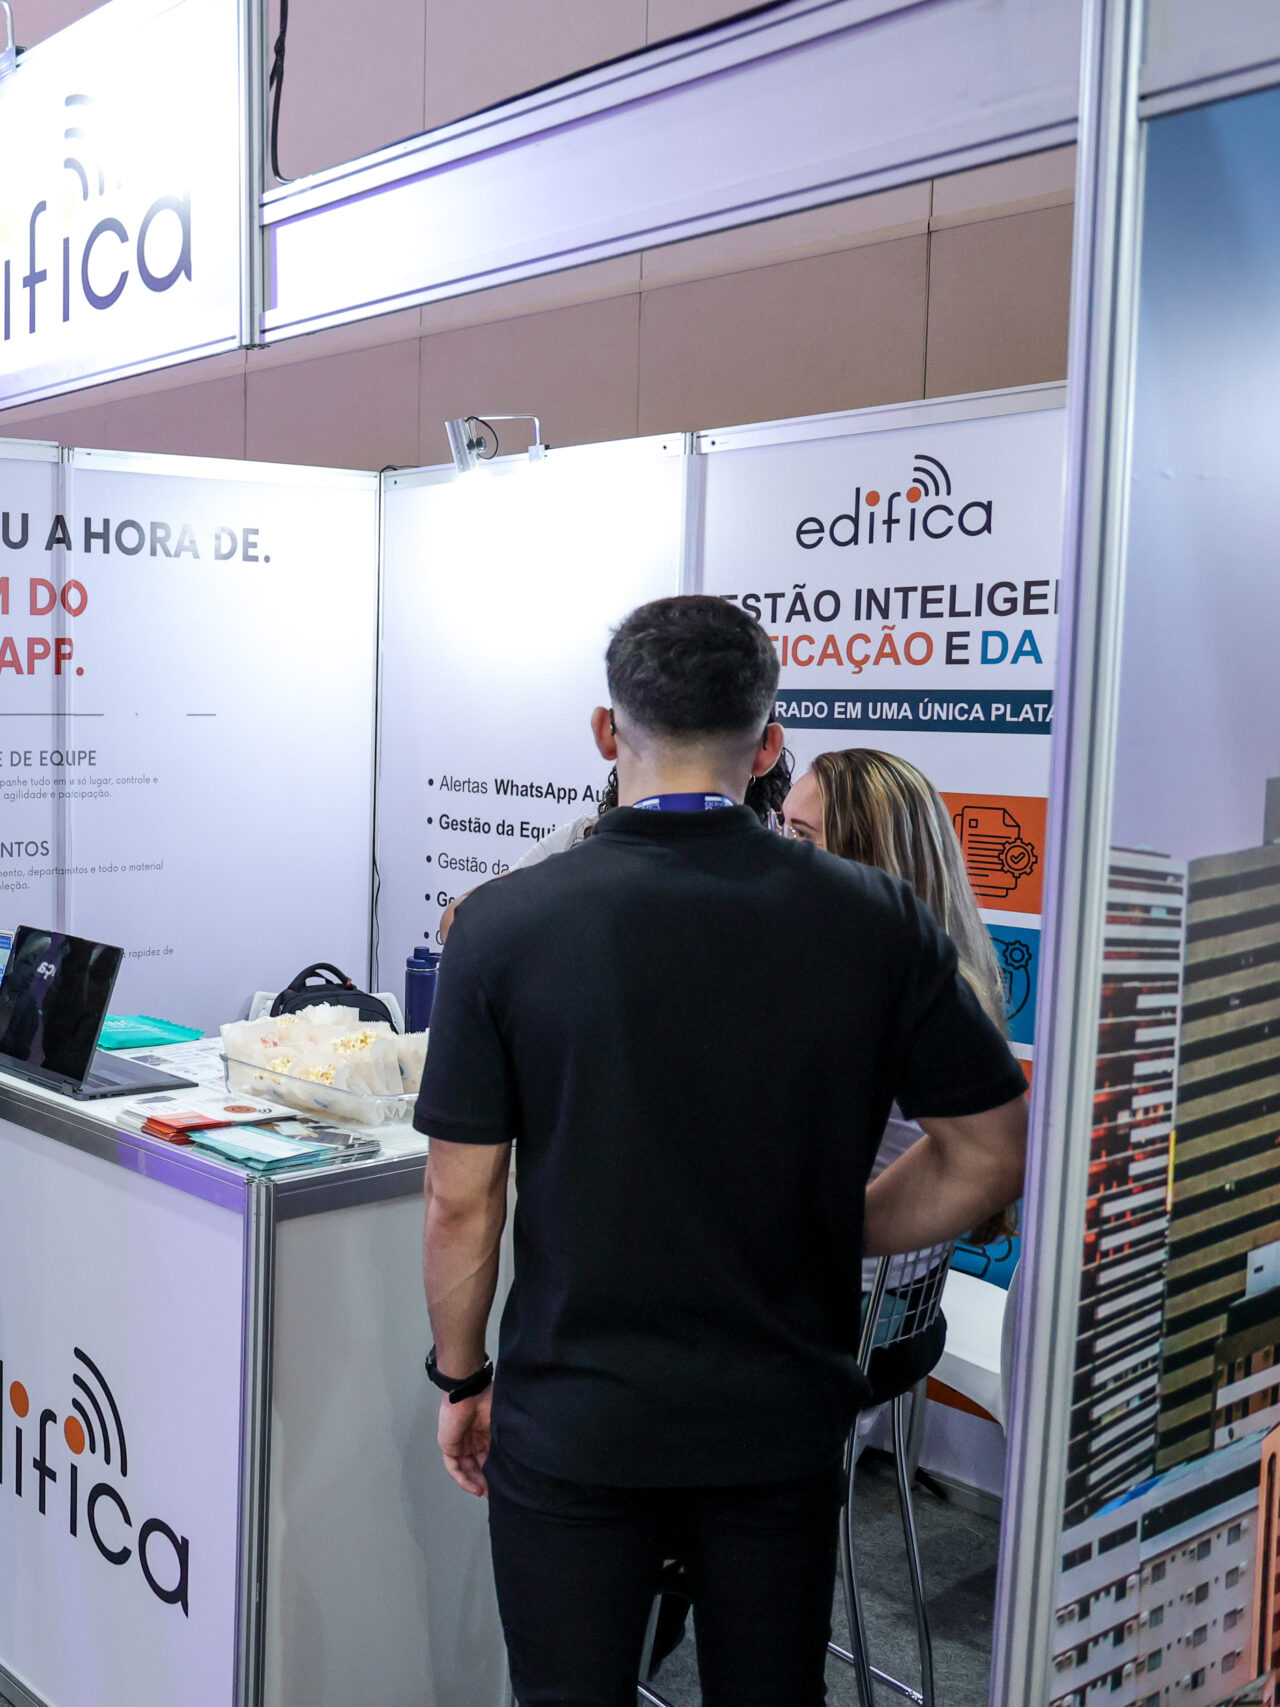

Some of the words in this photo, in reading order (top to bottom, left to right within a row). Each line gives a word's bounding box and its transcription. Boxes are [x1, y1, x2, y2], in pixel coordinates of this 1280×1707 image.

[796, 486, 993, 549] edifica
[44, 513, 73, 551] A
[83, 517, 201, 560] HORA
[213, 527, 272, 564] DE.
[30, 577, 88, 617] DO
[945, 631, 971, 665] E
[980, 629, 1043, 665] DA
[833, 702, 862, 720] EM
[868, 702, 913, 721] UMA
[919, 698, 985, 722] ÚNICA
[10, 751, 32, 767] DE
[30, 776, 51, 786] tudo
[89, 775, 114, 788] lugar,
[116, 774, 151, 785] controle
[439, 775, 488, 794] Alertas
[494, 778, 578, 804] WhatsApp
[3, 788, 48, 802] agilidade
[439, 814, 491, 834] Gestão
[496, 820, 514, 837] da
[99, 862, 119, 873] todo
[129, 859, 164, 871] material
[438, 852, 488, 874] Gestão
[129, 946, 161, 960] rapidez
[163, 945, 174, 955] de
